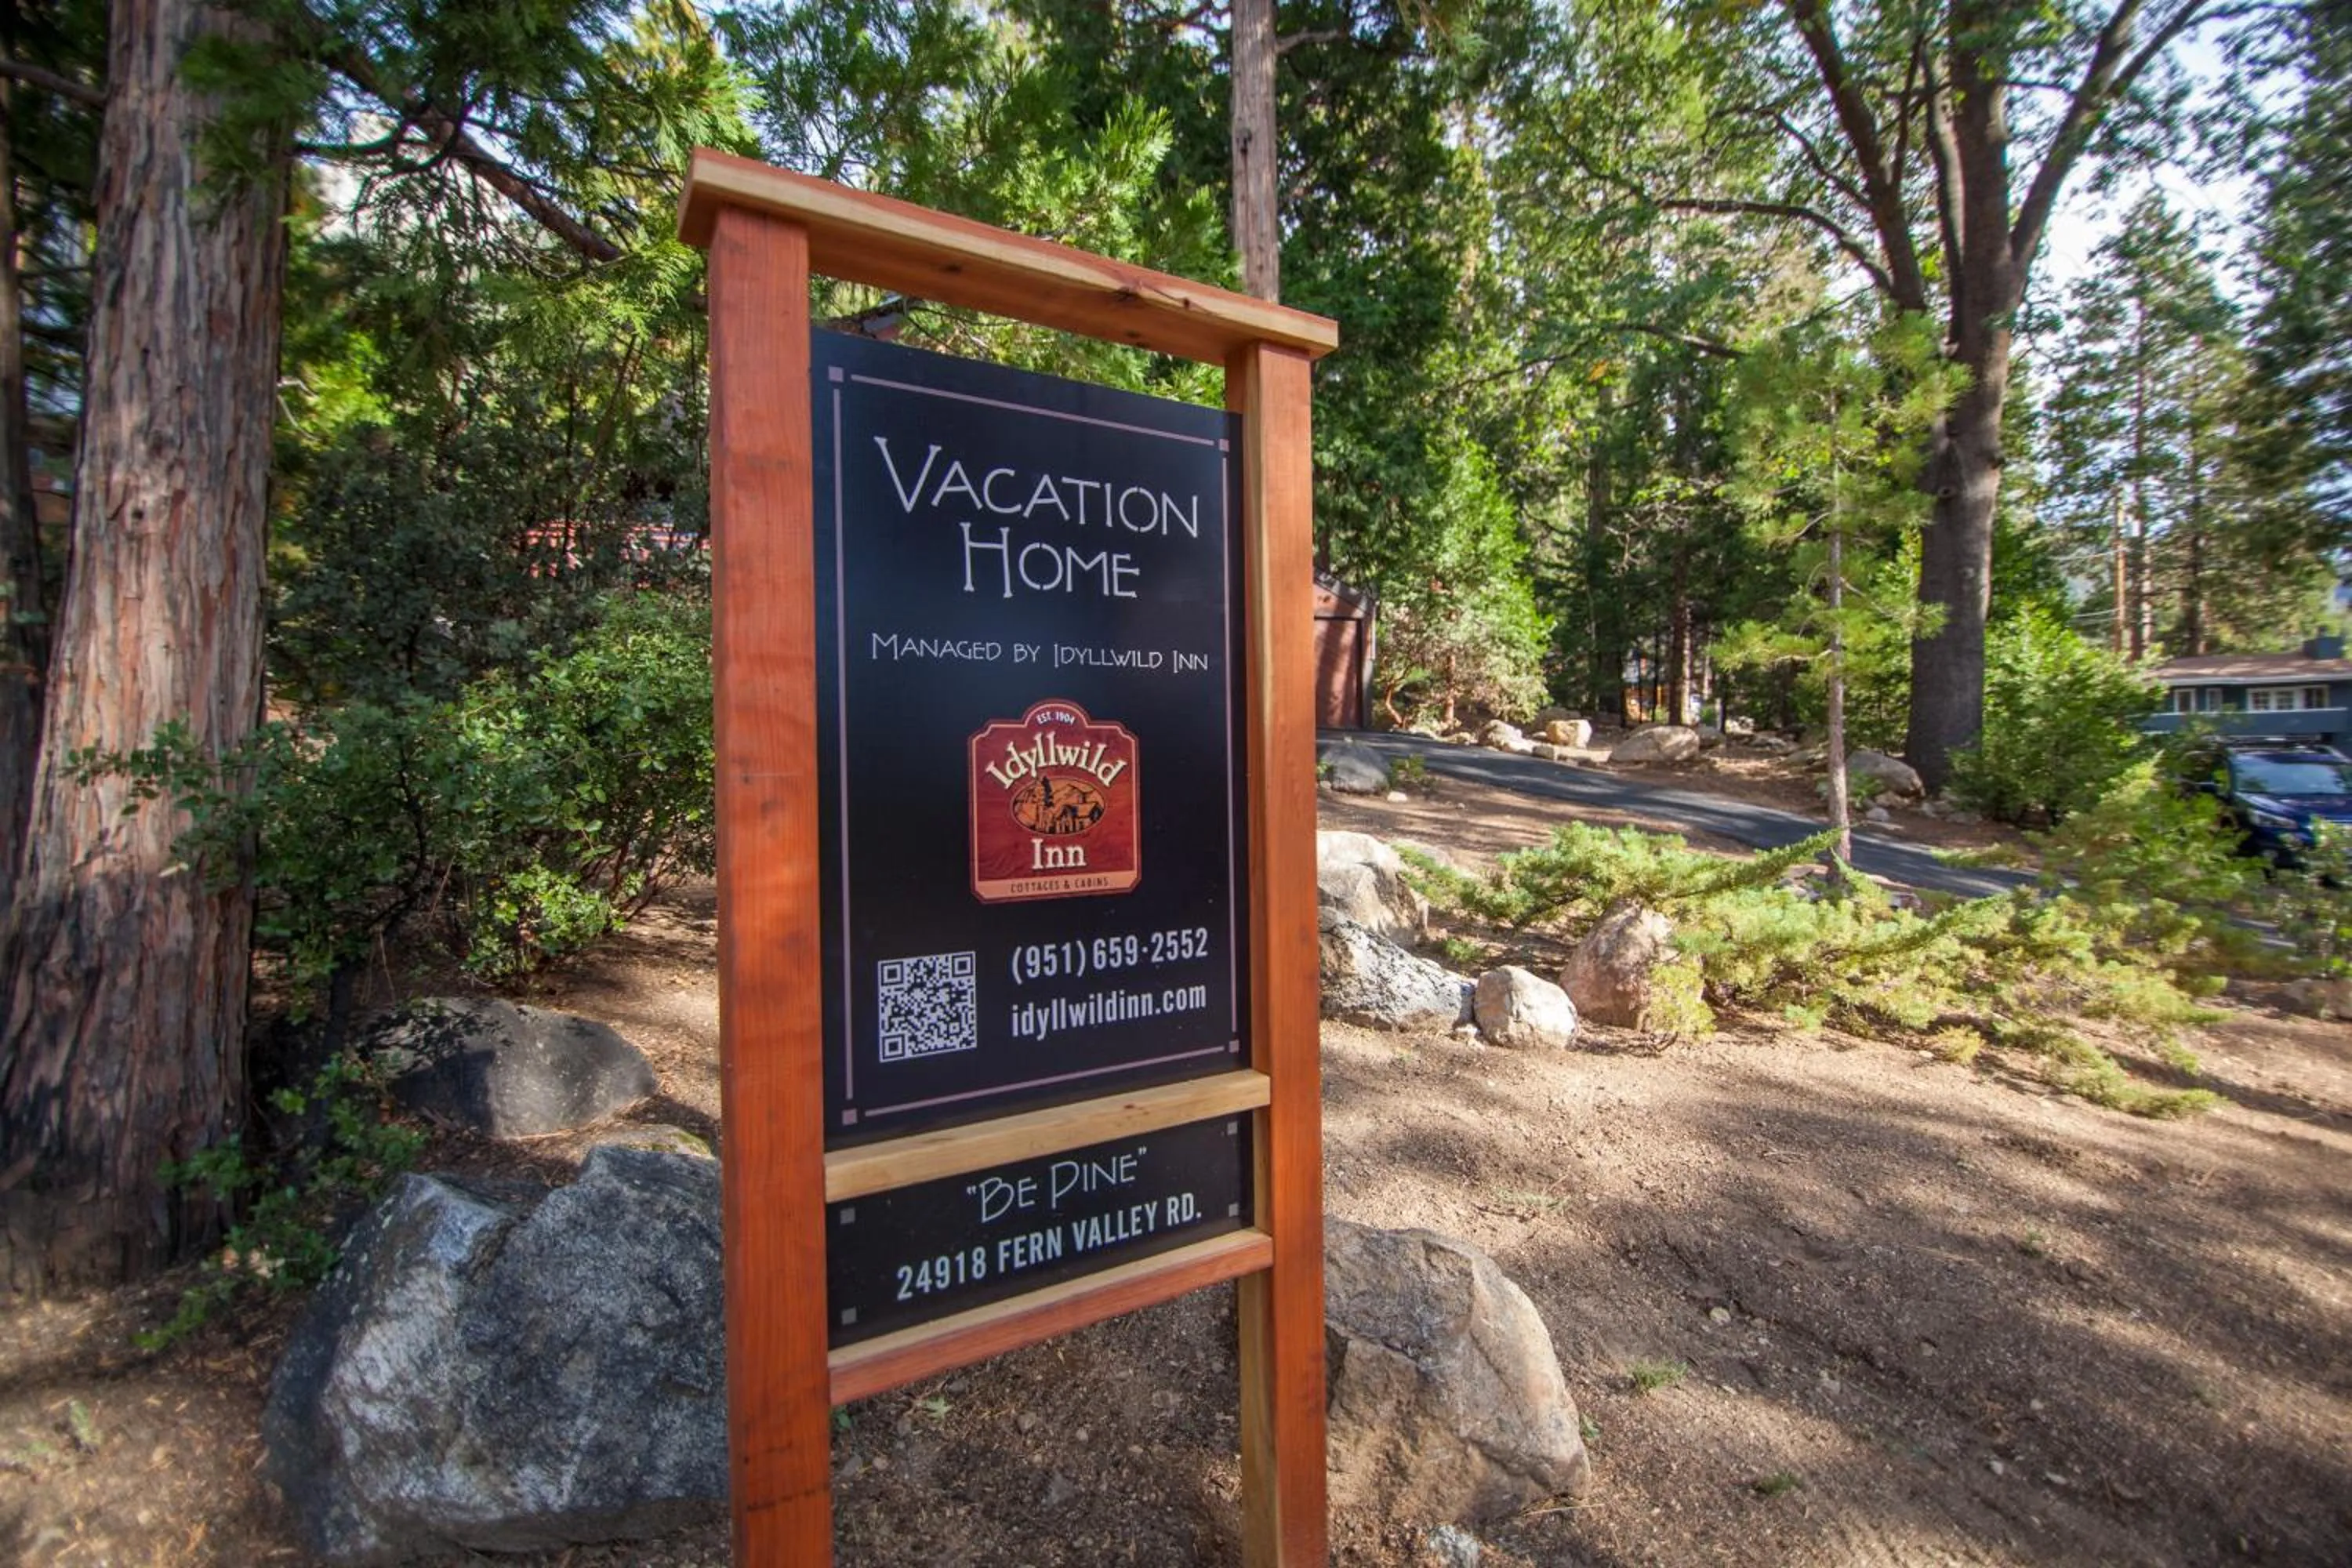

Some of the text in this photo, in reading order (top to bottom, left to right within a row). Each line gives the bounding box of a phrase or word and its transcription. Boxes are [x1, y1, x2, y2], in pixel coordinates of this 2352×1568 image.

[873, 436, 1199, 539] VACATION
[959, 522, 1140, 598] HOME
[872, 633, 1208, 674] MANAGED BY IDYLLWILD INN
[1055, 711, 1076, 725] 1904
[986, 731, 1127, 789] Idyllwild
[1031, 838, 1086, 869] Inn
[1010, 880, 1060, 893] COTTAGES
[1074, 877, 1109, 888] CABINS
[1011, 939, 1086, 985] (951)
[1011, 984, 1207, 1041] idyllwildinn.com
[896, 1192, 1202, 1301] 24918 FERN VALLEY RD.
